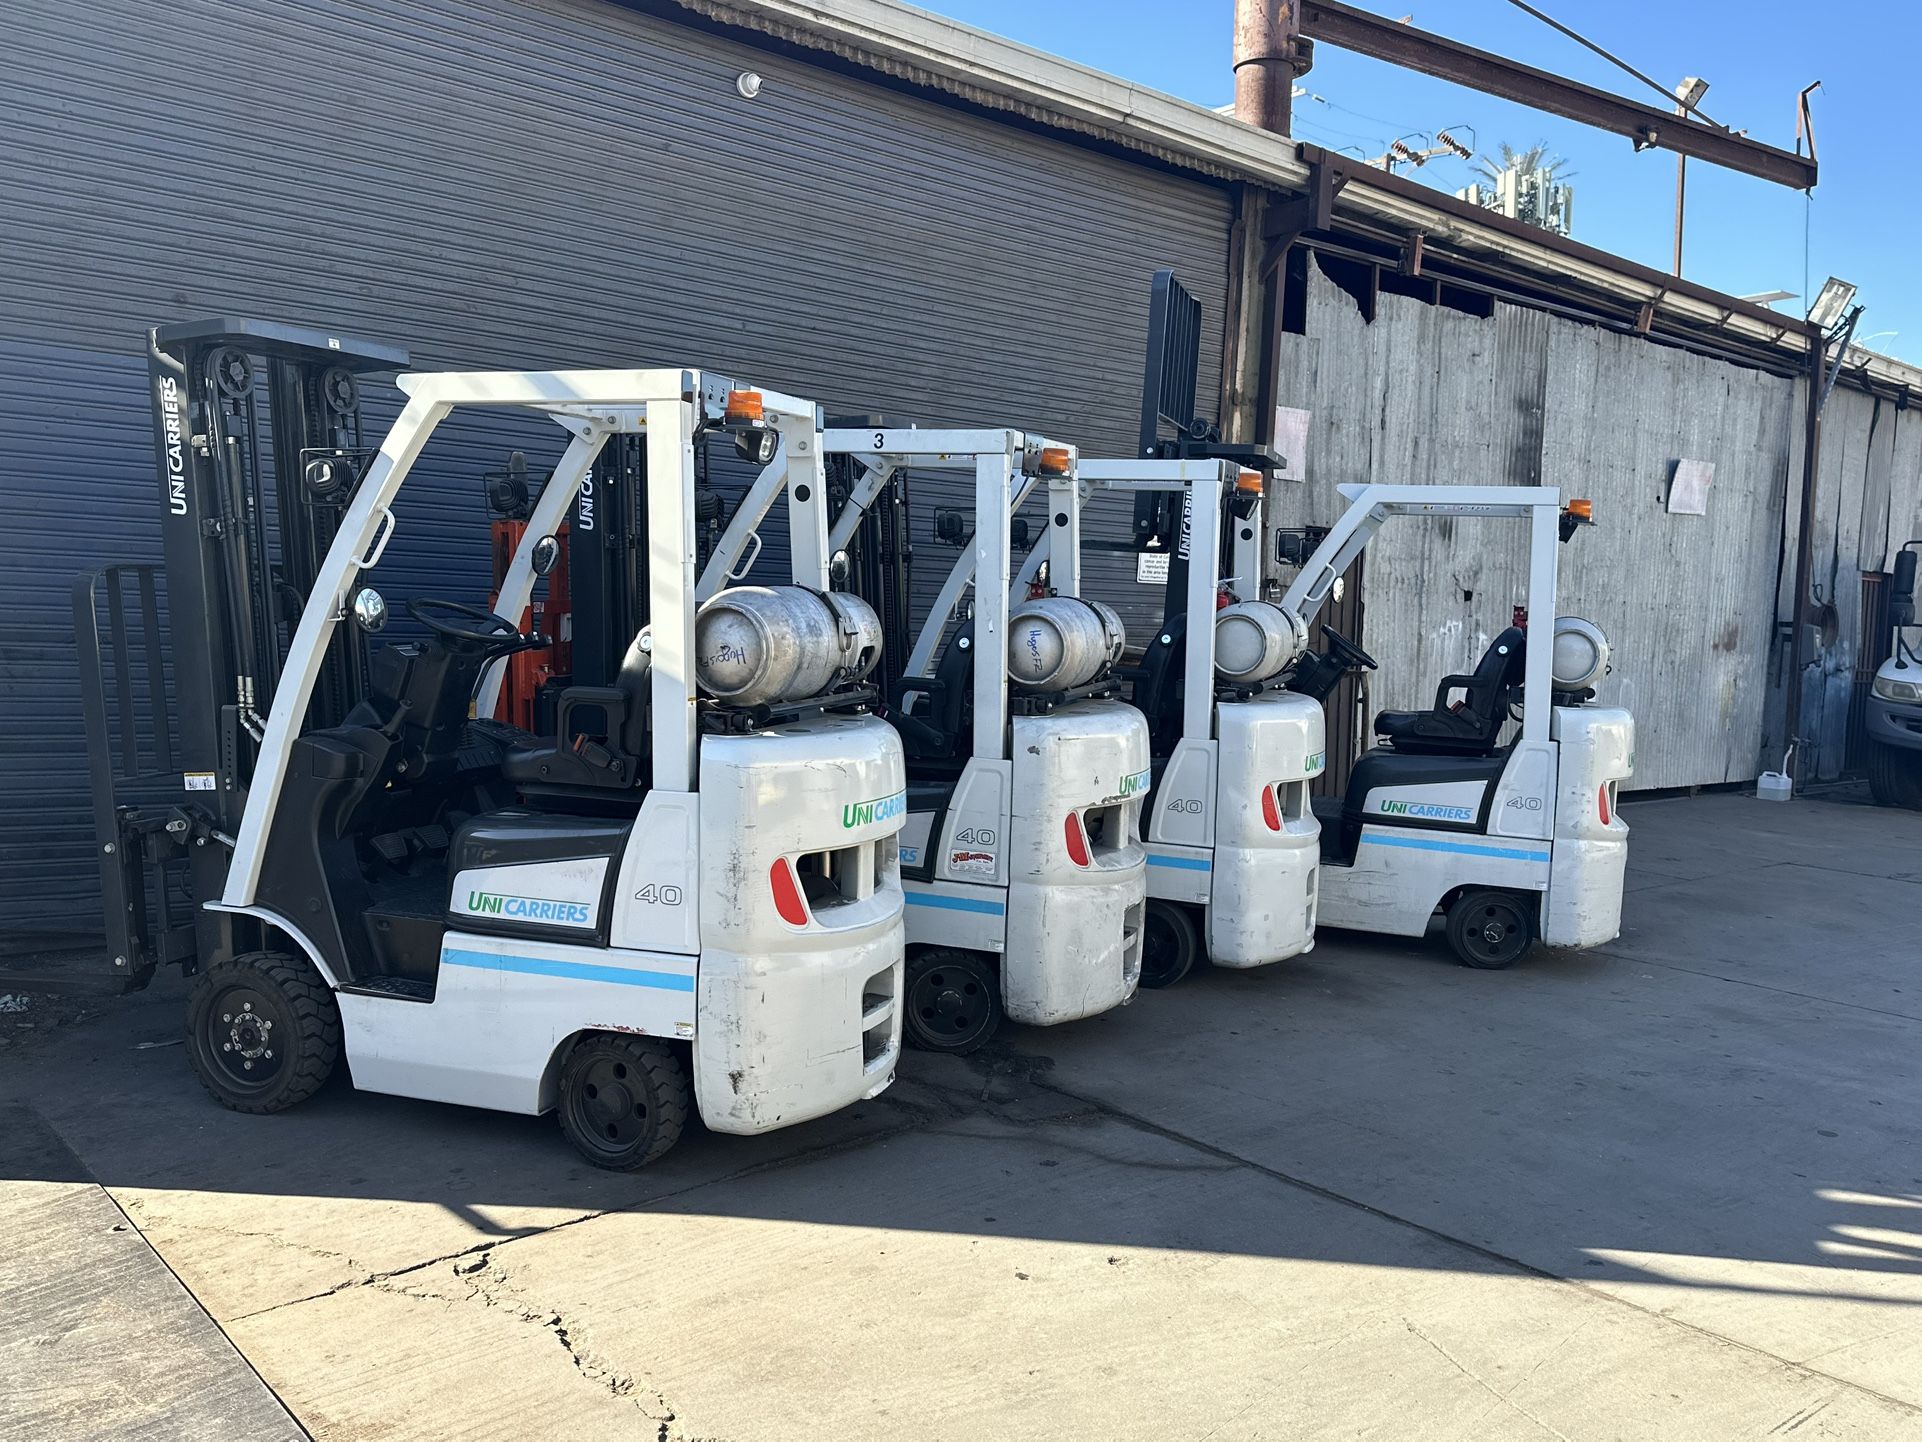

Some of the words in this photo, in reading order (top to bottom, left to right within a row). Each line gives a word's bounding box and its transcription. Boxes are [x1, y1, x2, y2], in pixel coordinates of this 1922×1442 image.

[874, 433, 884, 449] 3
[1167, 799, 1202, 813] 40
[1507, 797, 1542, 810] 40
[956, 828, 995, 845] 40
[635, 884, 682, 905] 40
